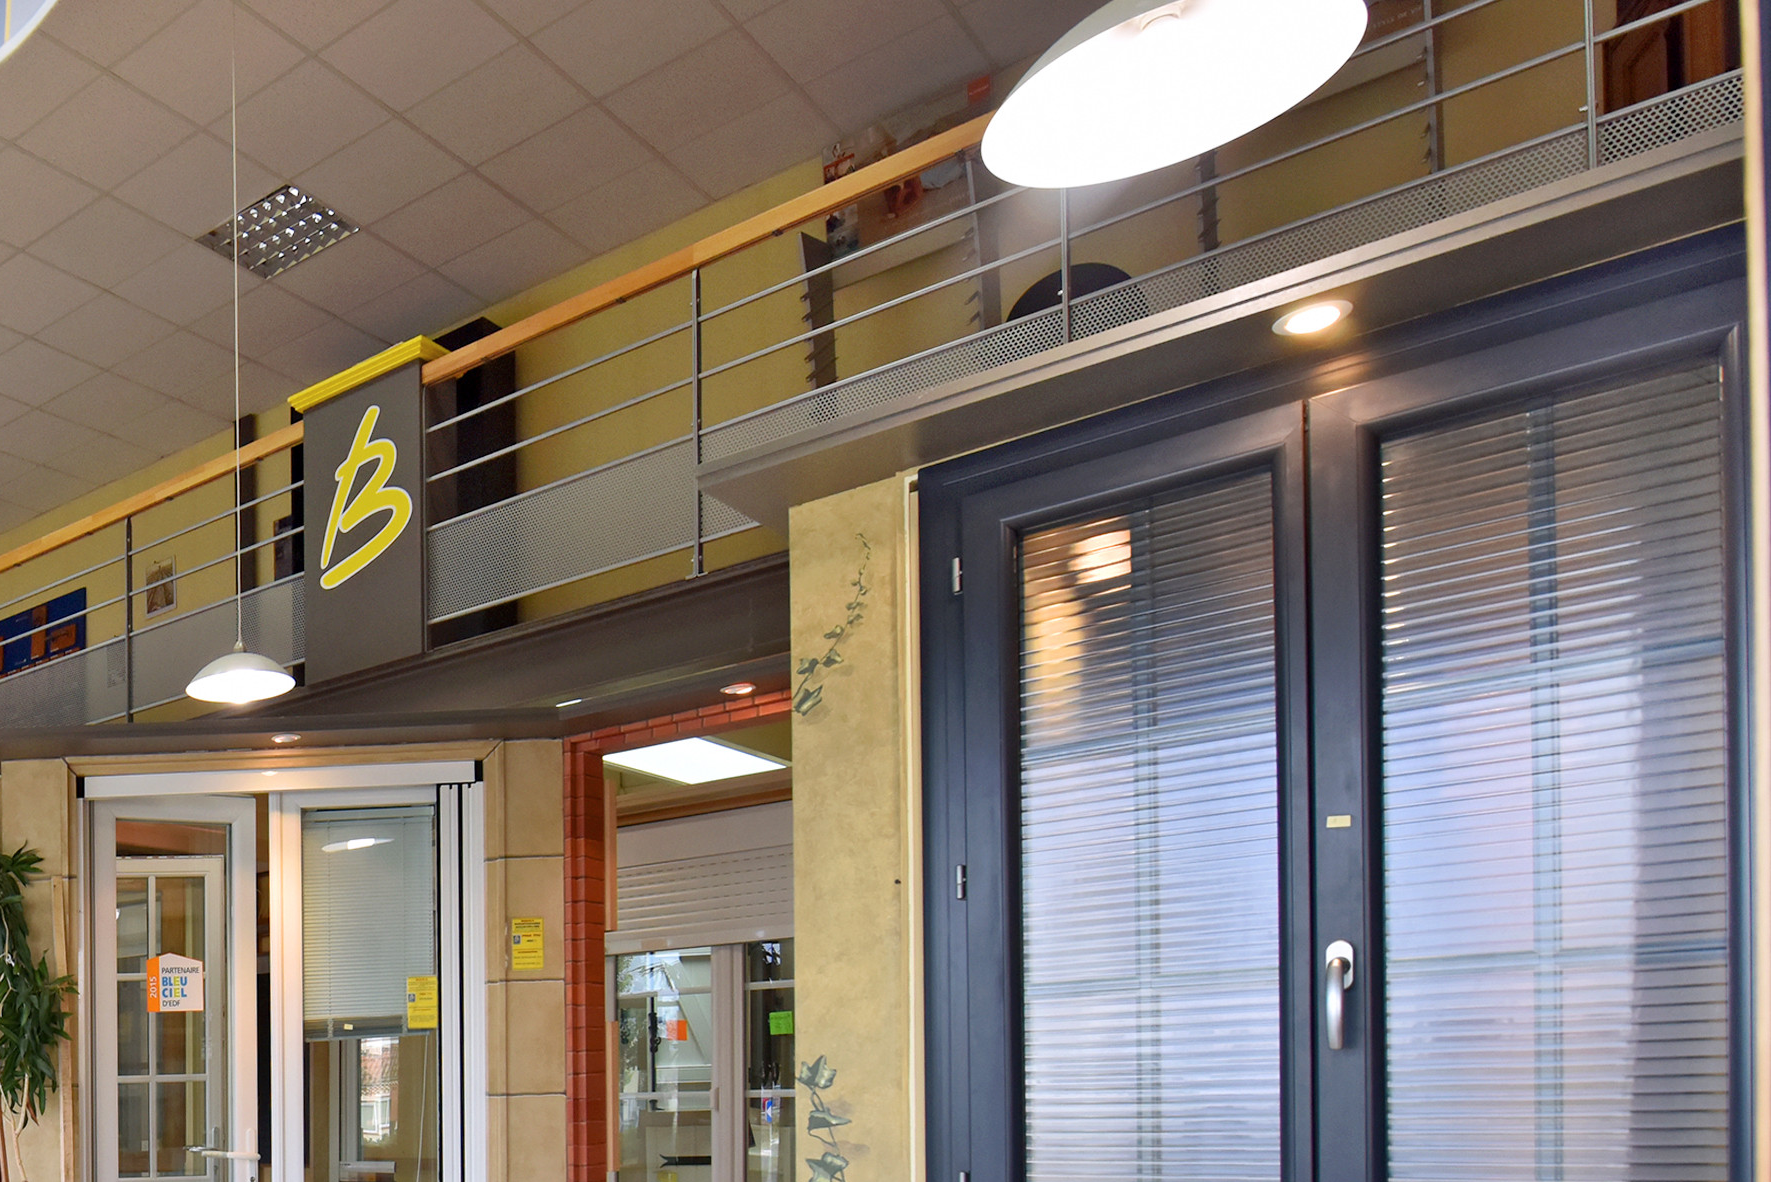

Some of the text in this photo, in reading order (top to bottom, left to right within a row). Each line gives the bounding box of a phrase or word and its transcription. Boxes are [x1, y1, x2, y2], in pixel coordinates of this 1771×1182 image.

[321, 405, 413, 589] B
[150, 976, 158, 998] 2015
[162, 976, 187, 986] BLEU
[162, 988, 187, 998] CIEL
